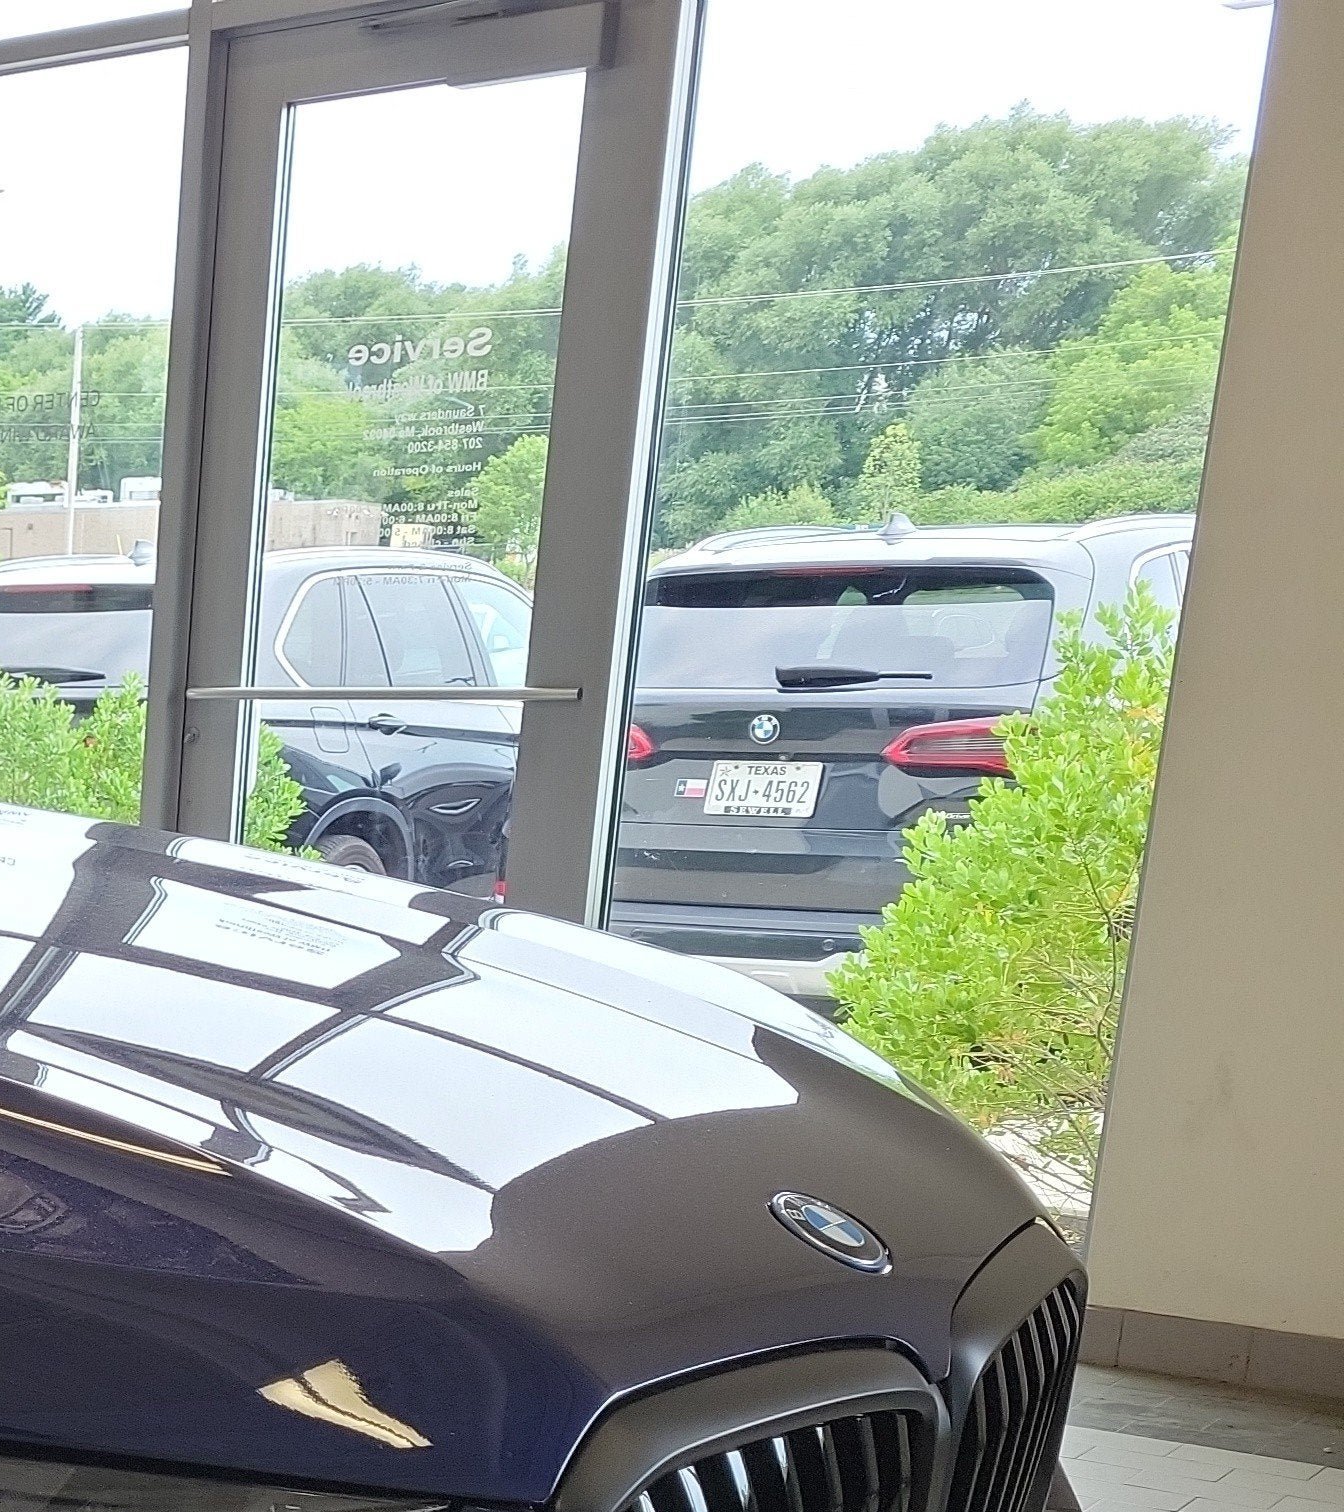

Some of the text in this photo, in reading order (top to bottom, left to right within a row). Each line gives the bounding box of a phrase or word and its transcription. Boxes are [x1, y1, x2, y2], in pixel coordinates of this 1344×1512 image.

[747, 764, 787, 777] TEXAS
[714, 779, 810, 804] SXJ 4562
